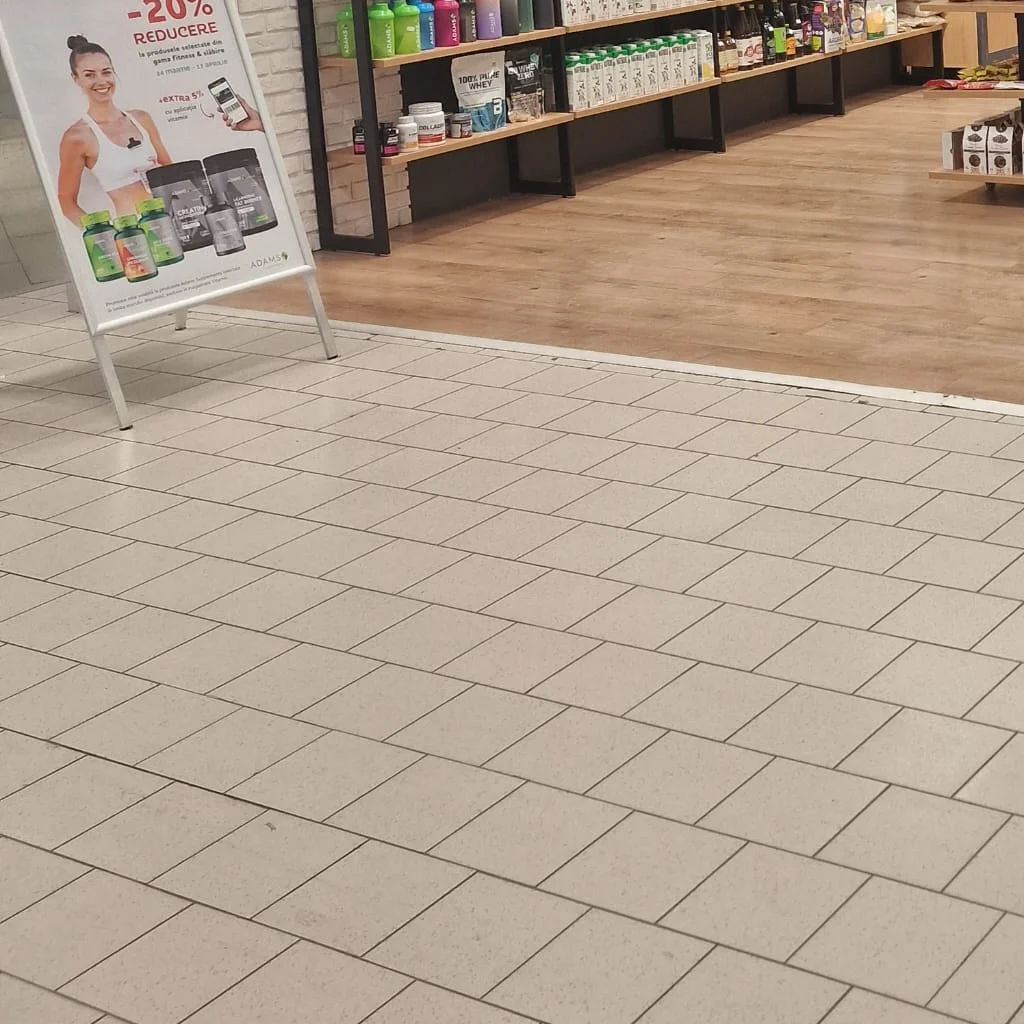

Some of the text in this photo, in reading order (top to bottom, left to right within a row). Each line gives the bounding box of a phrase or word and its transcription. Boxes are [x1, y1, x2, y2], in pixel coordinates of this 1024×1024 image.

[133, 21, 218, 45] REDUCERE
[469, 80, 492, 90] WHEY
[251, 255, 281, 269] ADAMS
